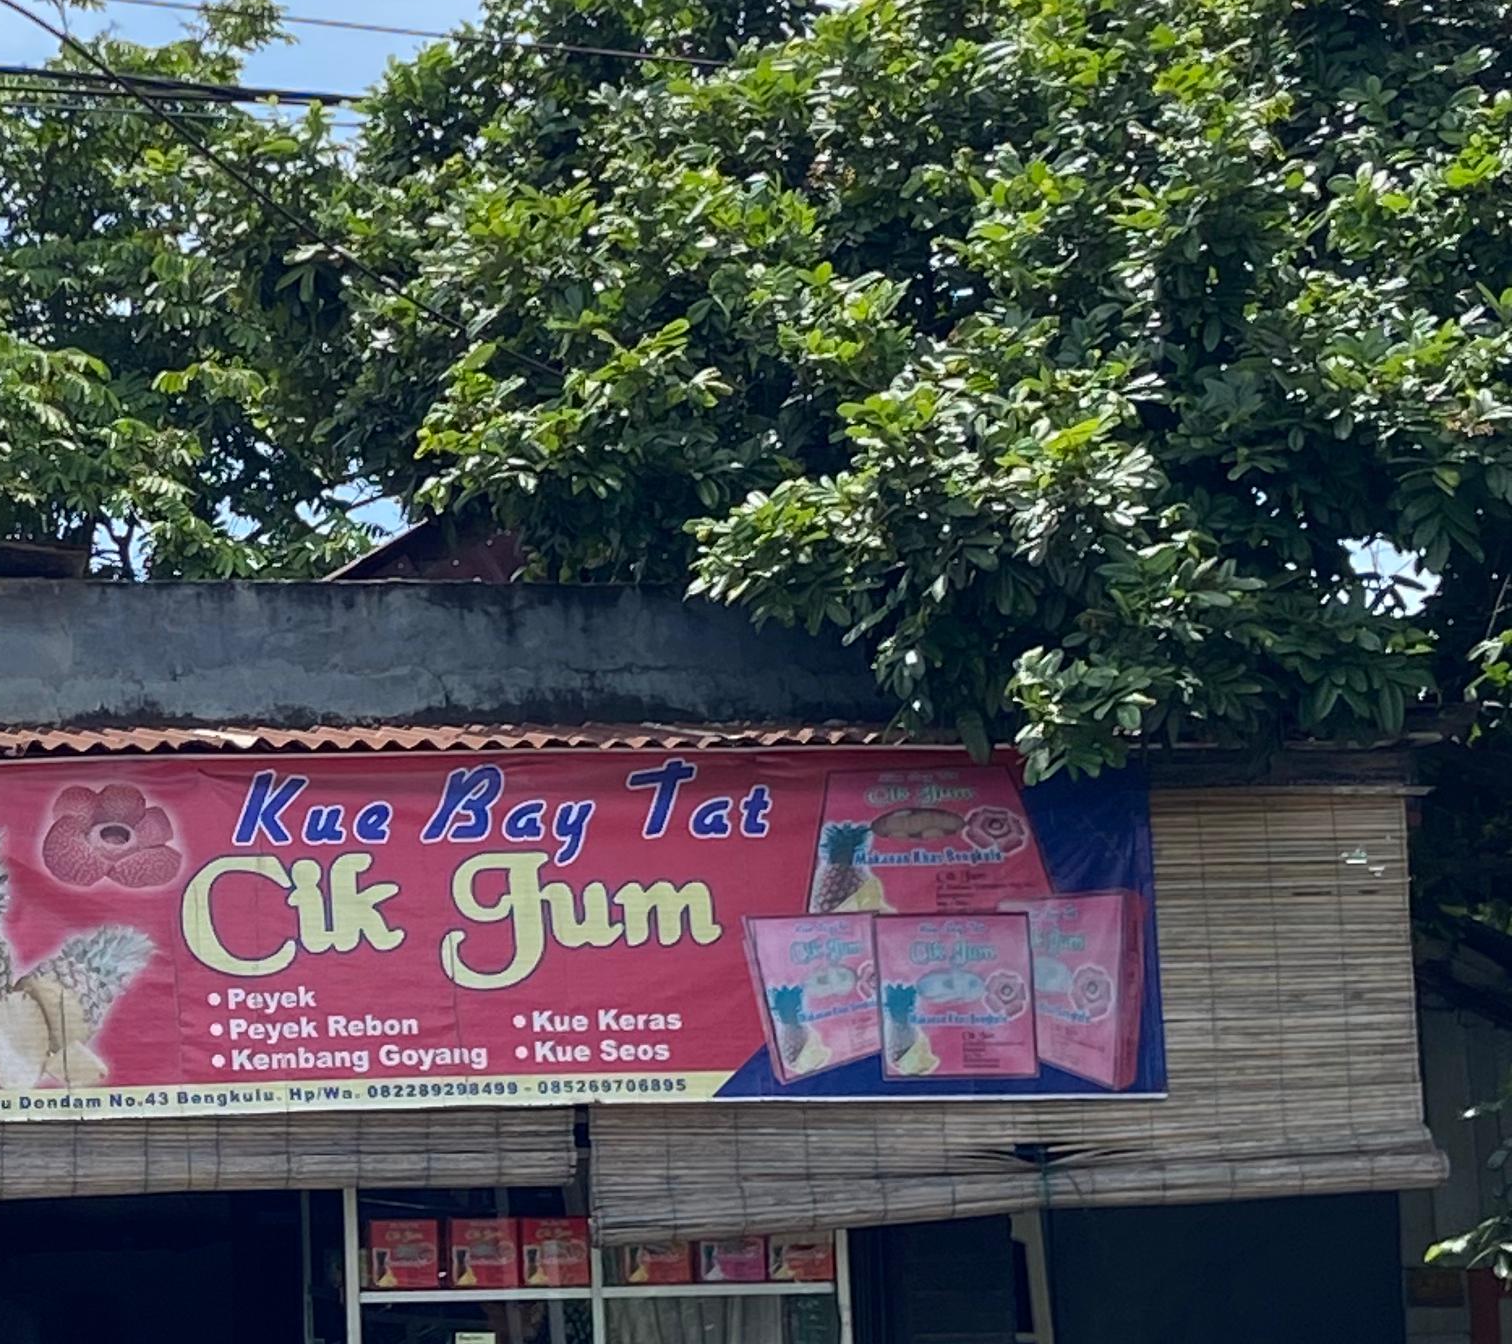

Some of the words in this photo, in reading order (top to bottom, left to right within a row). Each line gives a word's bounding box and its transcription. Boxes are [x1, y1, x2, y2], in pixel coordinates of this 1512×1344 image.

[232, 768, 392, 847] Kue
[420, 763, 595, 865] Bay
[626, 757, 773, 839] Tat
[181, 852, 405, 977] Cik
[227, 986, 316, 1014] Peyek
[229, 1016, 318, 1044] Peyek
[327, 1014, 419, 1037] Rebon
[532, 1010, 589, 1033] Kue
[597, 1009, 683, 1031] Keras
[231, 1047, 370, 1073] Kembang
[378, 1044, 488, 1071] Goyang
[534, 1040, 591, 1063] Kue
[600, 1039, 671, 1061] Seos
[19, 1095, 101, 1109] Dendam
[109, 1092, 169, 1107] No.43
[177, 1088, 282, 1106] Bengkulu.
[367, 1081, 518, 1099] 082289298499
[537, 1078, 687, 1094] 085269706895
